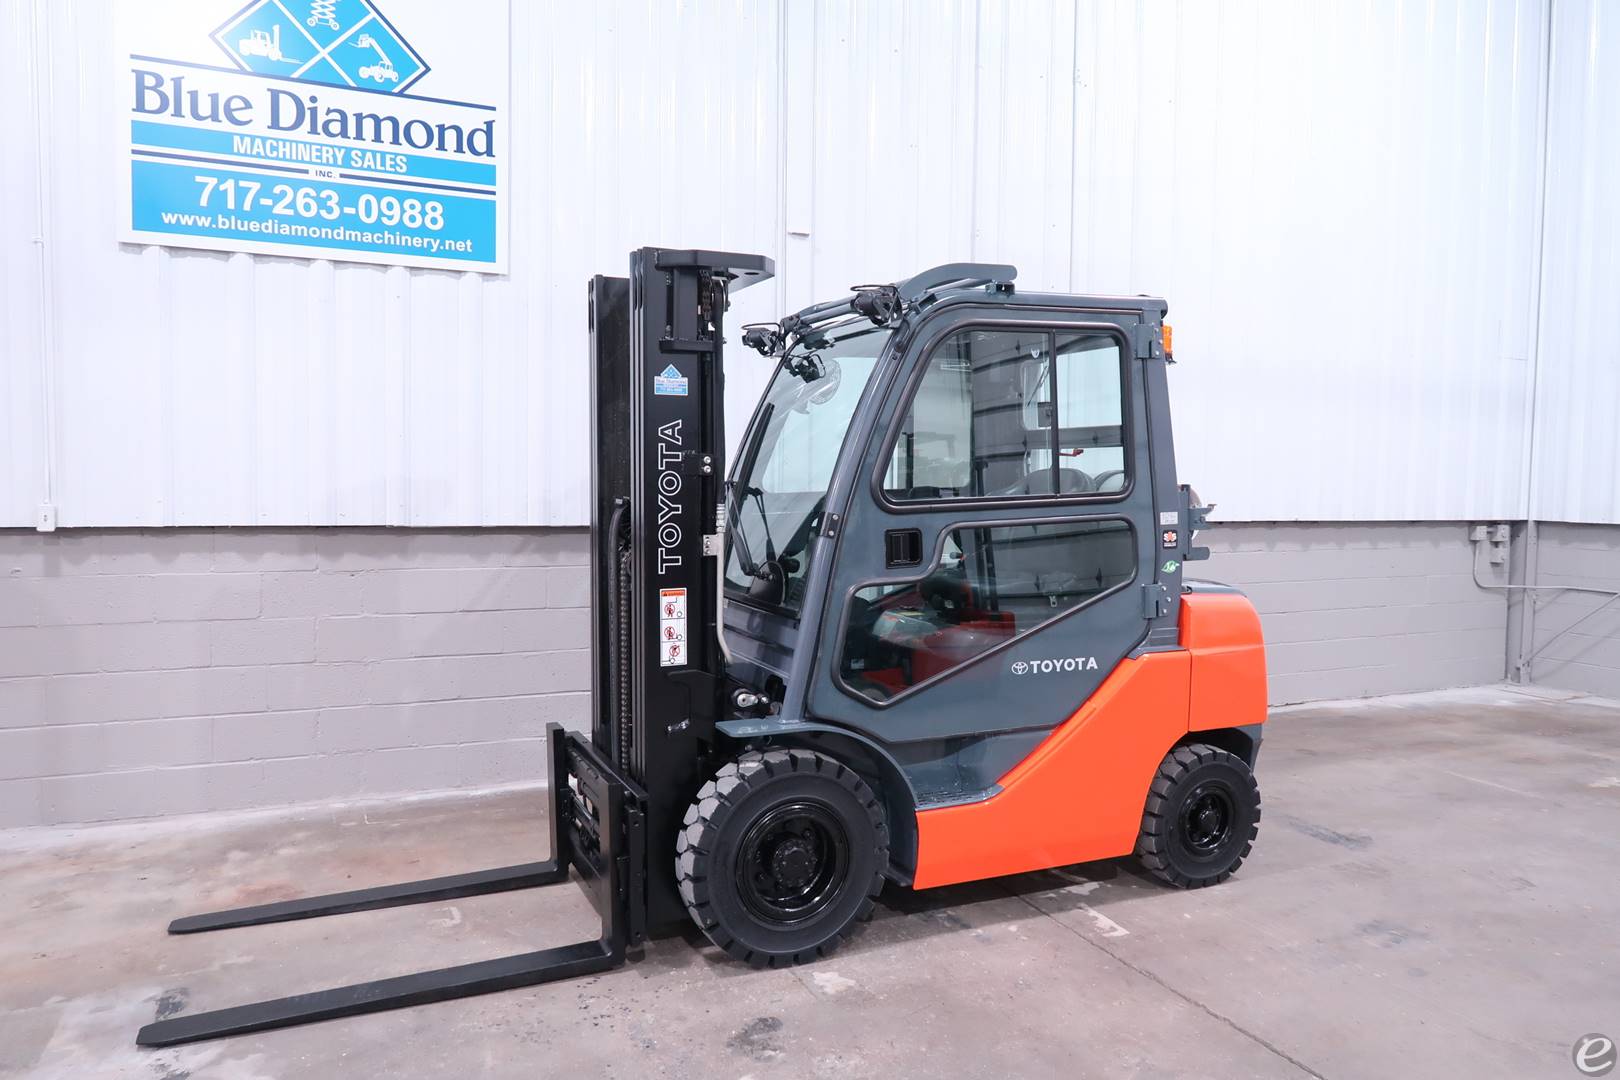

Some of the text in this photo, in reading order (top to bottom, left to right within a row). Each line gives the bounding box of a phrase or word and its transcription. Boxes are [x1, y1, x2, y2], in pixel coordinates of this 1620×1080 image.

[131, 69, 496, 158] Blue Diamond
[233, 135, 408, 174] MACHINERY SALES
[314, 169, 336, 179] INC.
[194, 175, 445, 231] 717-263-0988
[161, 212, 473, 253] www.bluediamondmachinery.net
[658, 419, 682, 575] TOYOTA
[1030, 657, 1098, 674] TOYOTA
